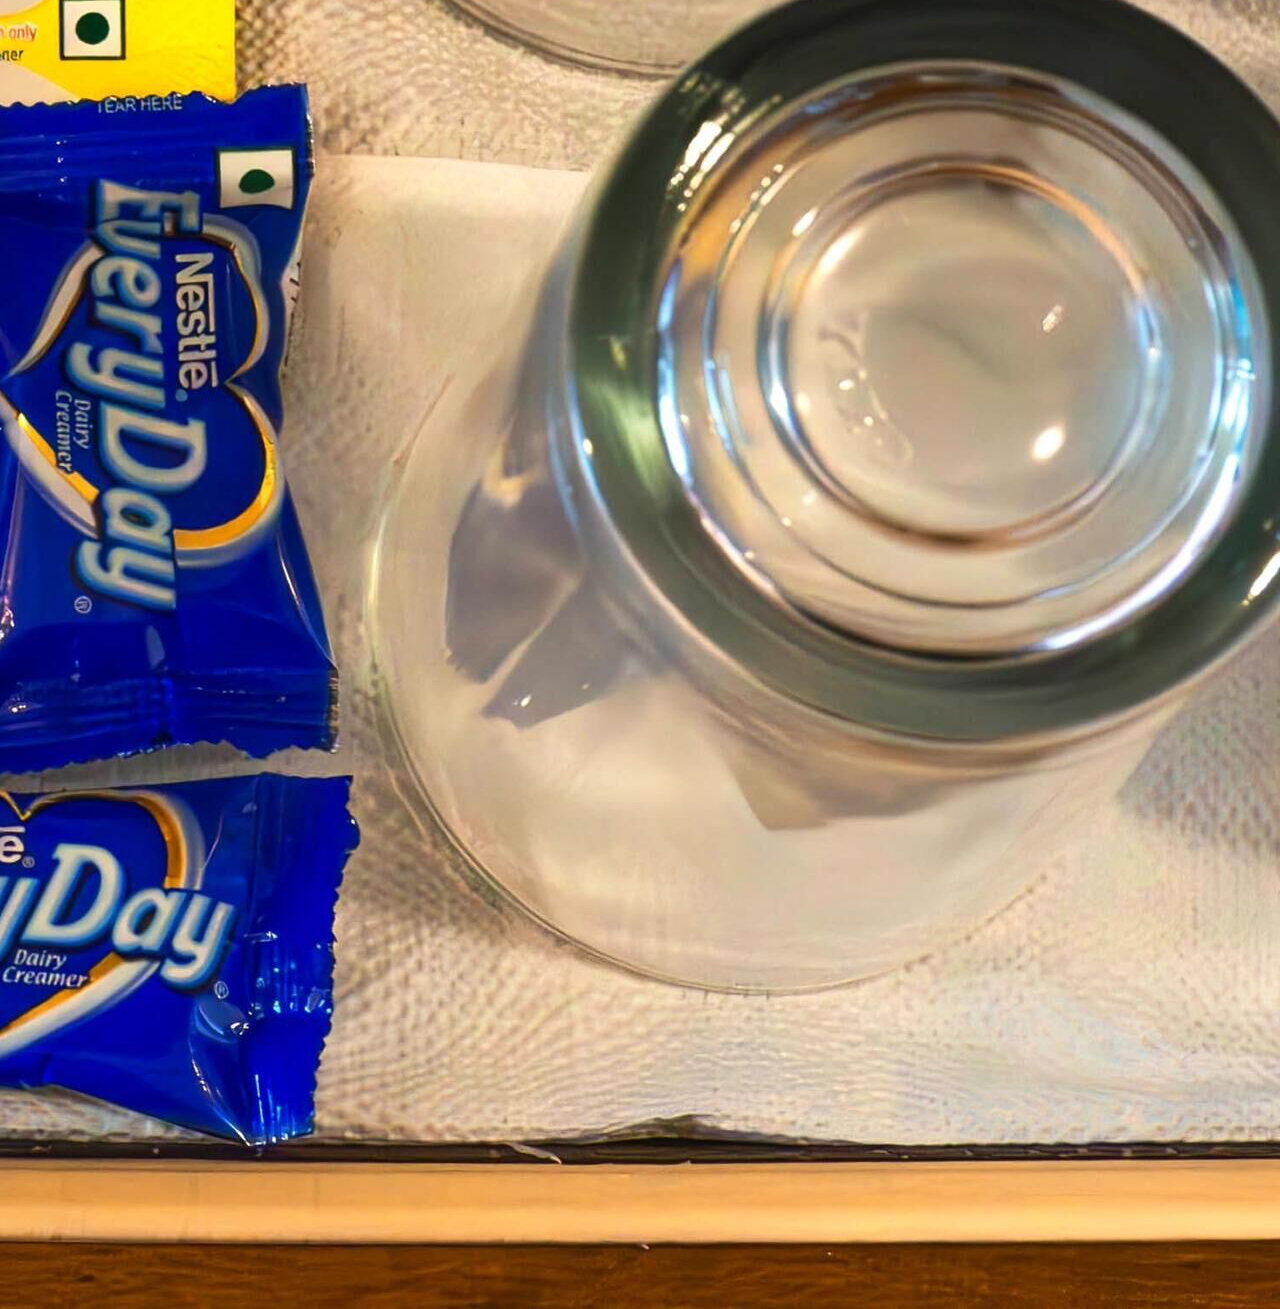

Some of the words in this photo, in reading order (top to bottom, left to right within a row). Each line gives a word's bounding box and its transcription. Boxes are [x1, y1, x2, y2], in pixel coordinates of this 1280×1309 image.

[9, 24, 38, 42] only
[140, 93, 183, 111] HERE
[66, 179, 207, 610] EveryDay
[56, 390, 73, 473] Creamer
[74, 398, 92, 450] Dairy
[14, 948, 66, 969] Dairy
[2, 966, 88, 988] Creamer
